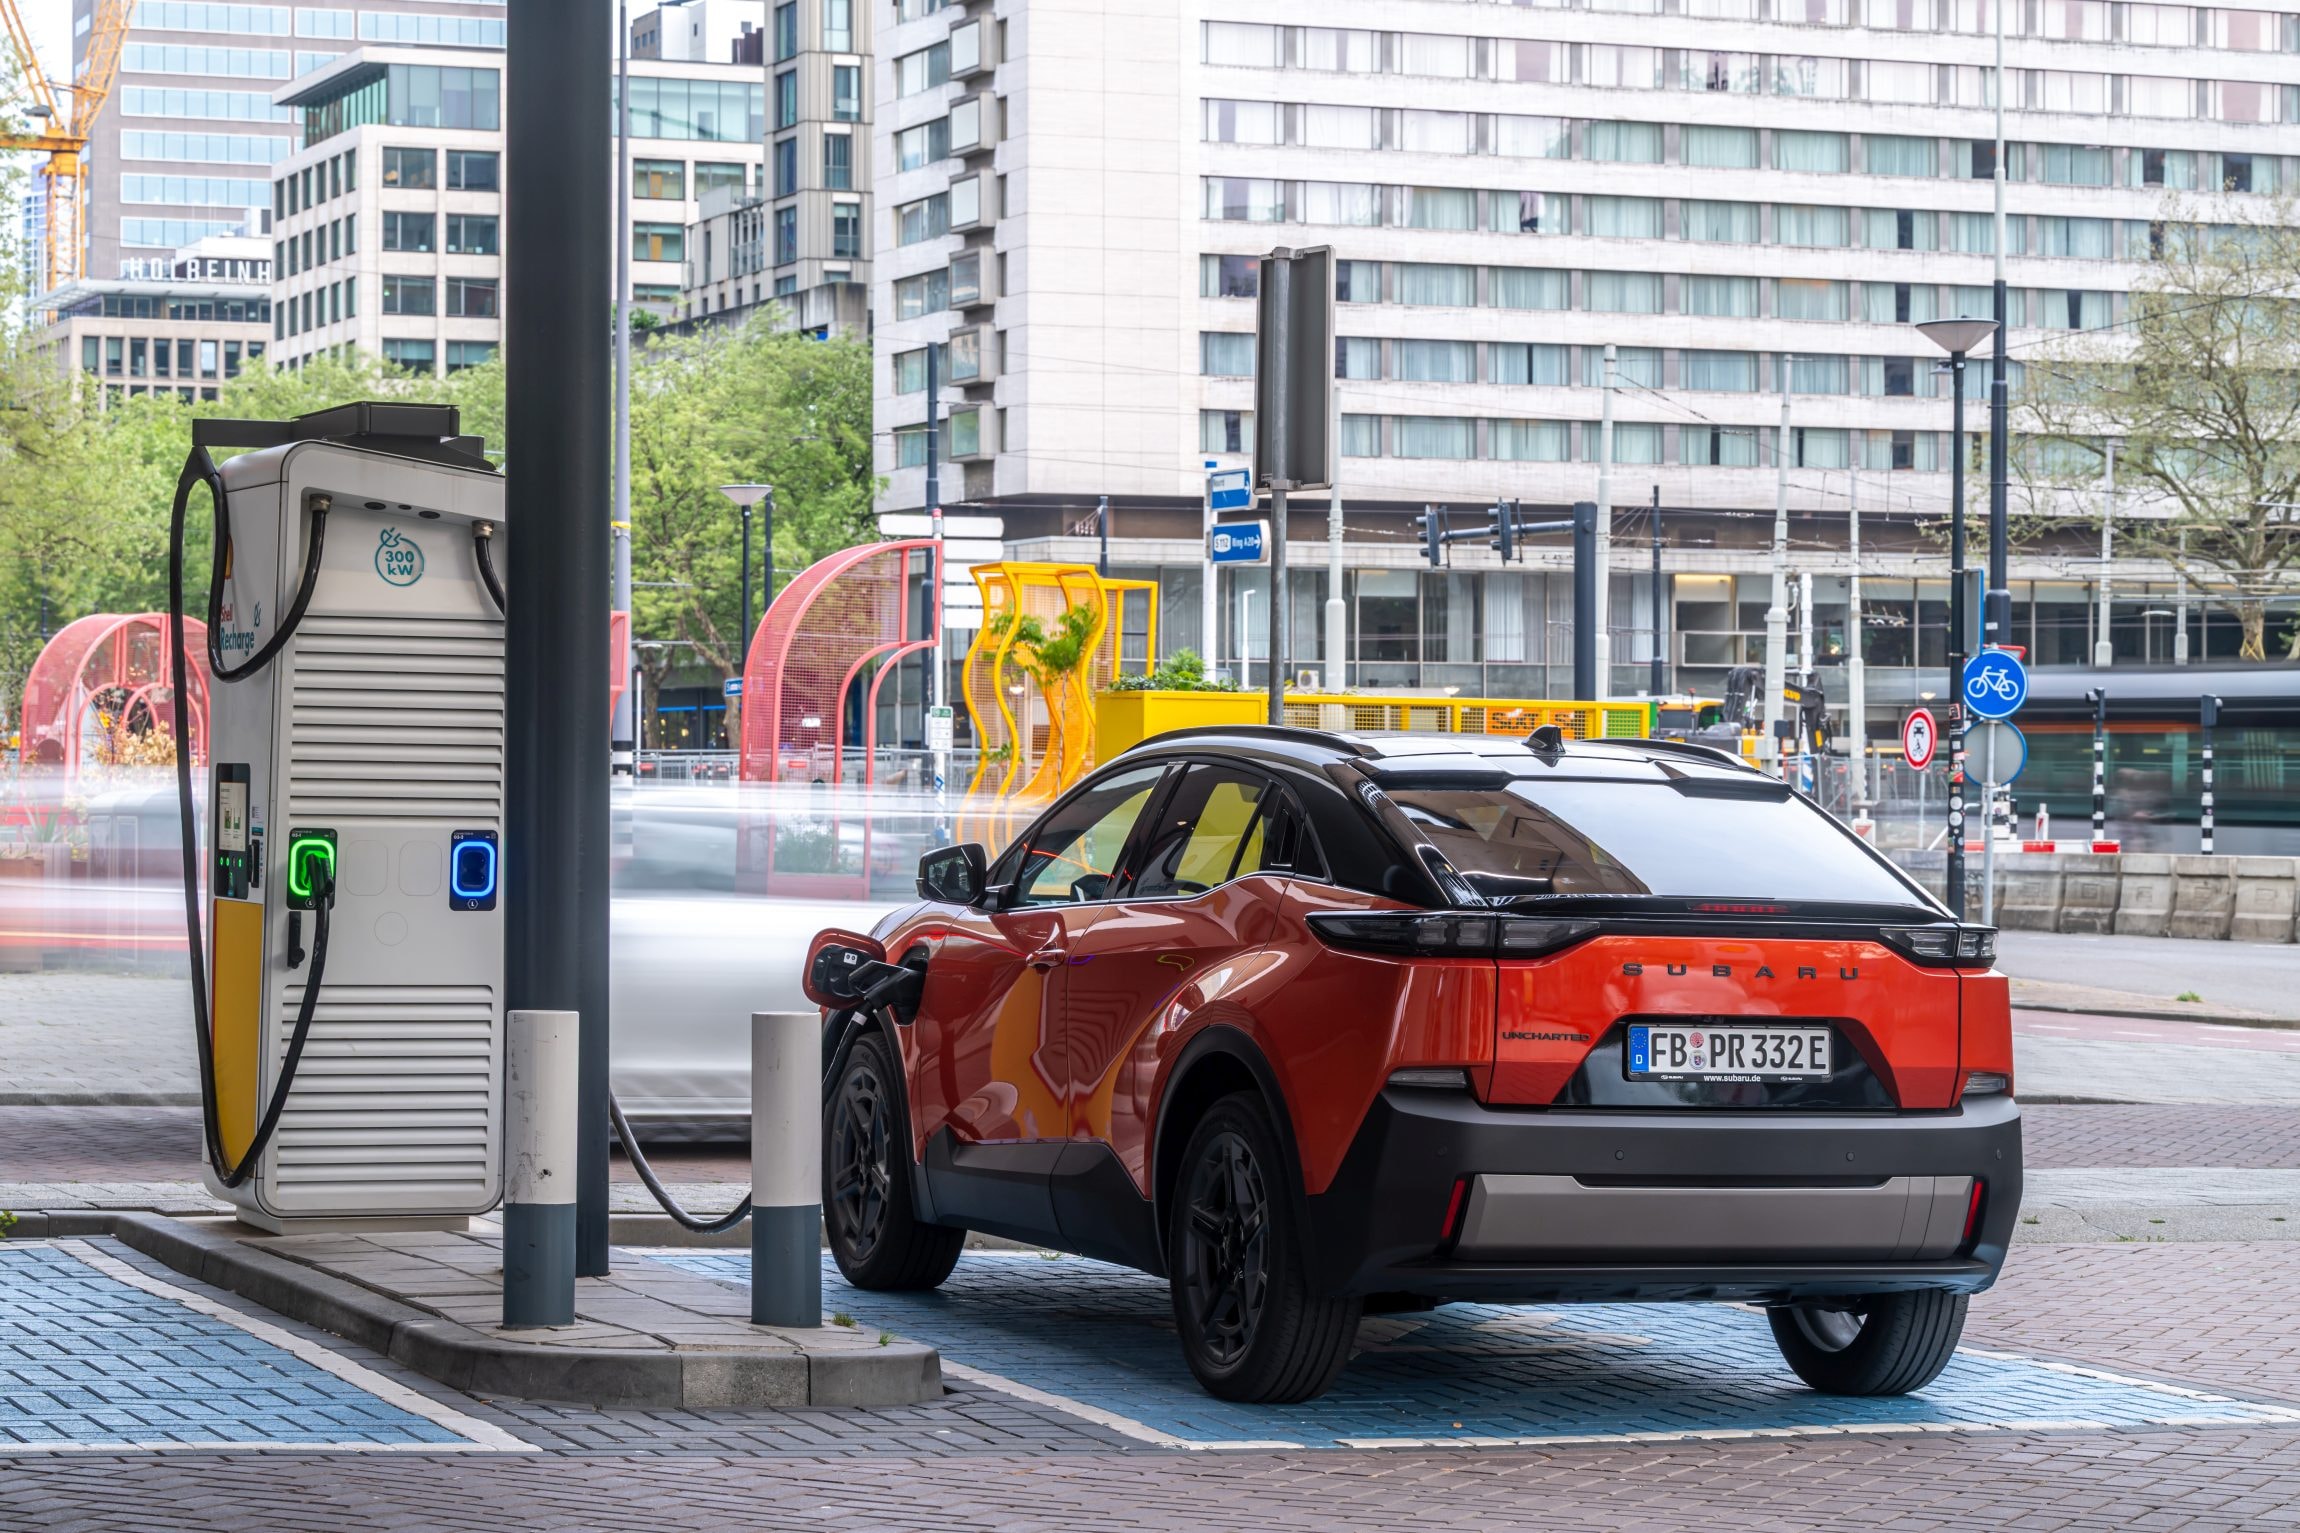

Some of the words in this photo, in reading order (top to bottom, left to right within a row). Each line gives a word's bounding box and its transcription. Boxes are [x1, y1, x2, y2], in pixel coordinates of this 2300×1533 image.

[129, 257, 272, 285] HOLBEINH
[385, 550, 415, 563] 300
[387, 563, 414, 576] kW
[220, 624, 255, 656] Recharge
[1622, 963, 1859, 981] SUBARU
[1502, 1031, 1591, 1042] UNCHARTED
[1650, 1032, 1688, 1068] FB
[1635, 1054, 1643, 1065] D
[1703, 1074, 1761, 1083] www.subaru.de
